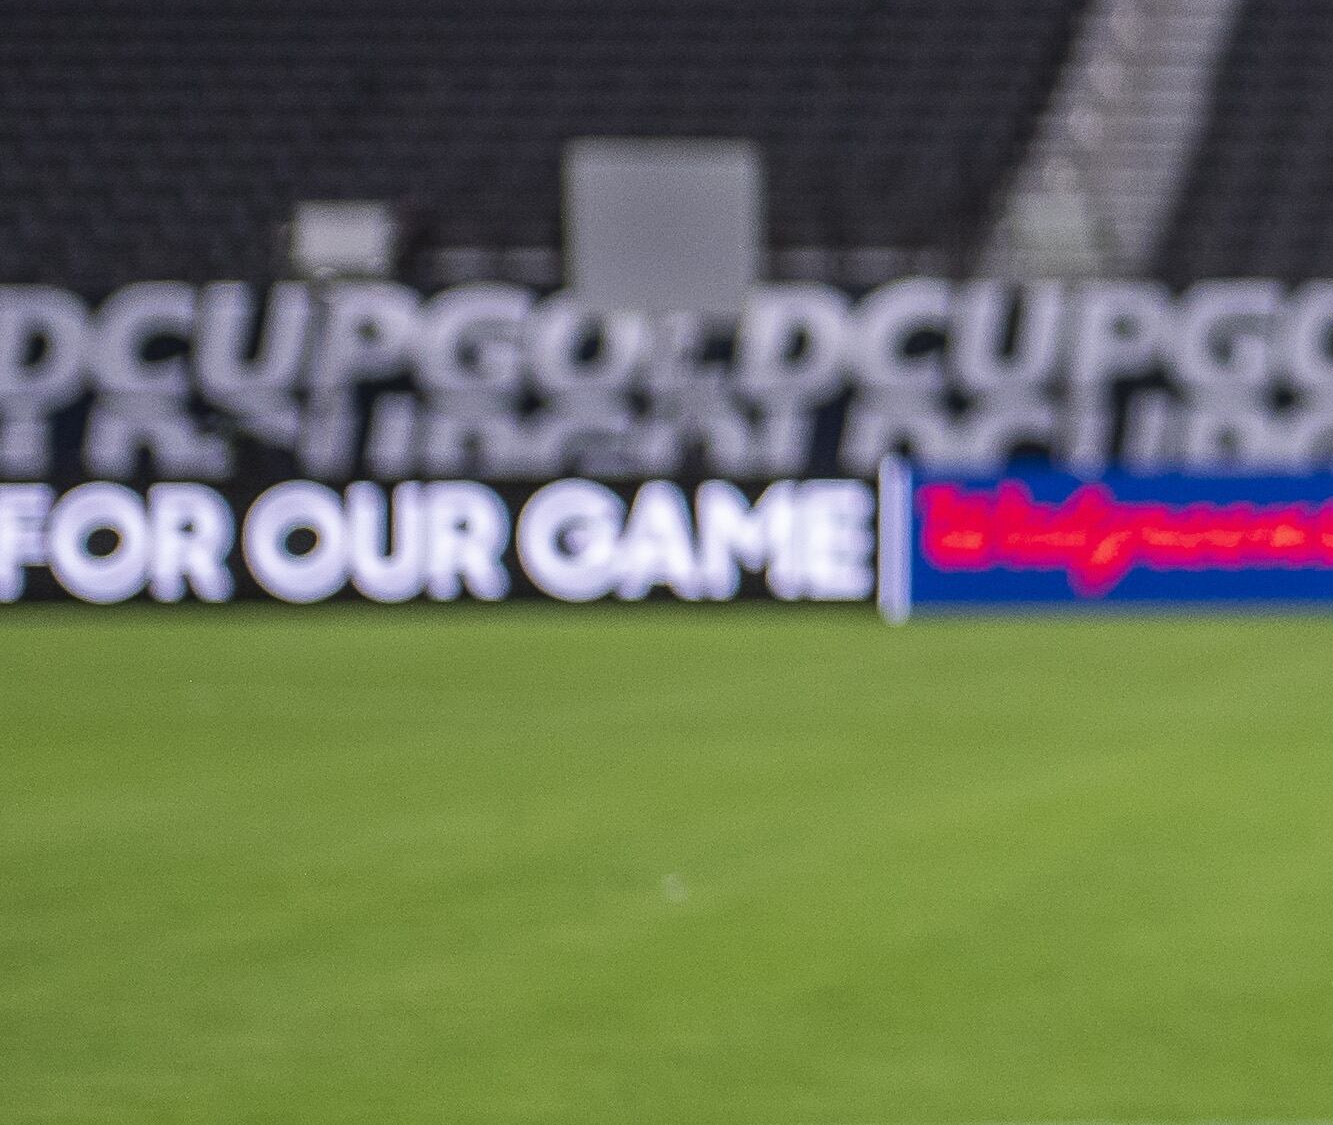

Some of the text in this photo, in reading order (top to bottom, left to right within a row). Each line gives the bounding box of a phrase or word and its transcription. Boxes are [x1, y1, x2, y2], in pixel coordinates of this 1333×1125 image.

[0, 480, 237, 603] FOR
[242, 479, 512, 603] OUR
[515, 478, 876, 603] GAME
